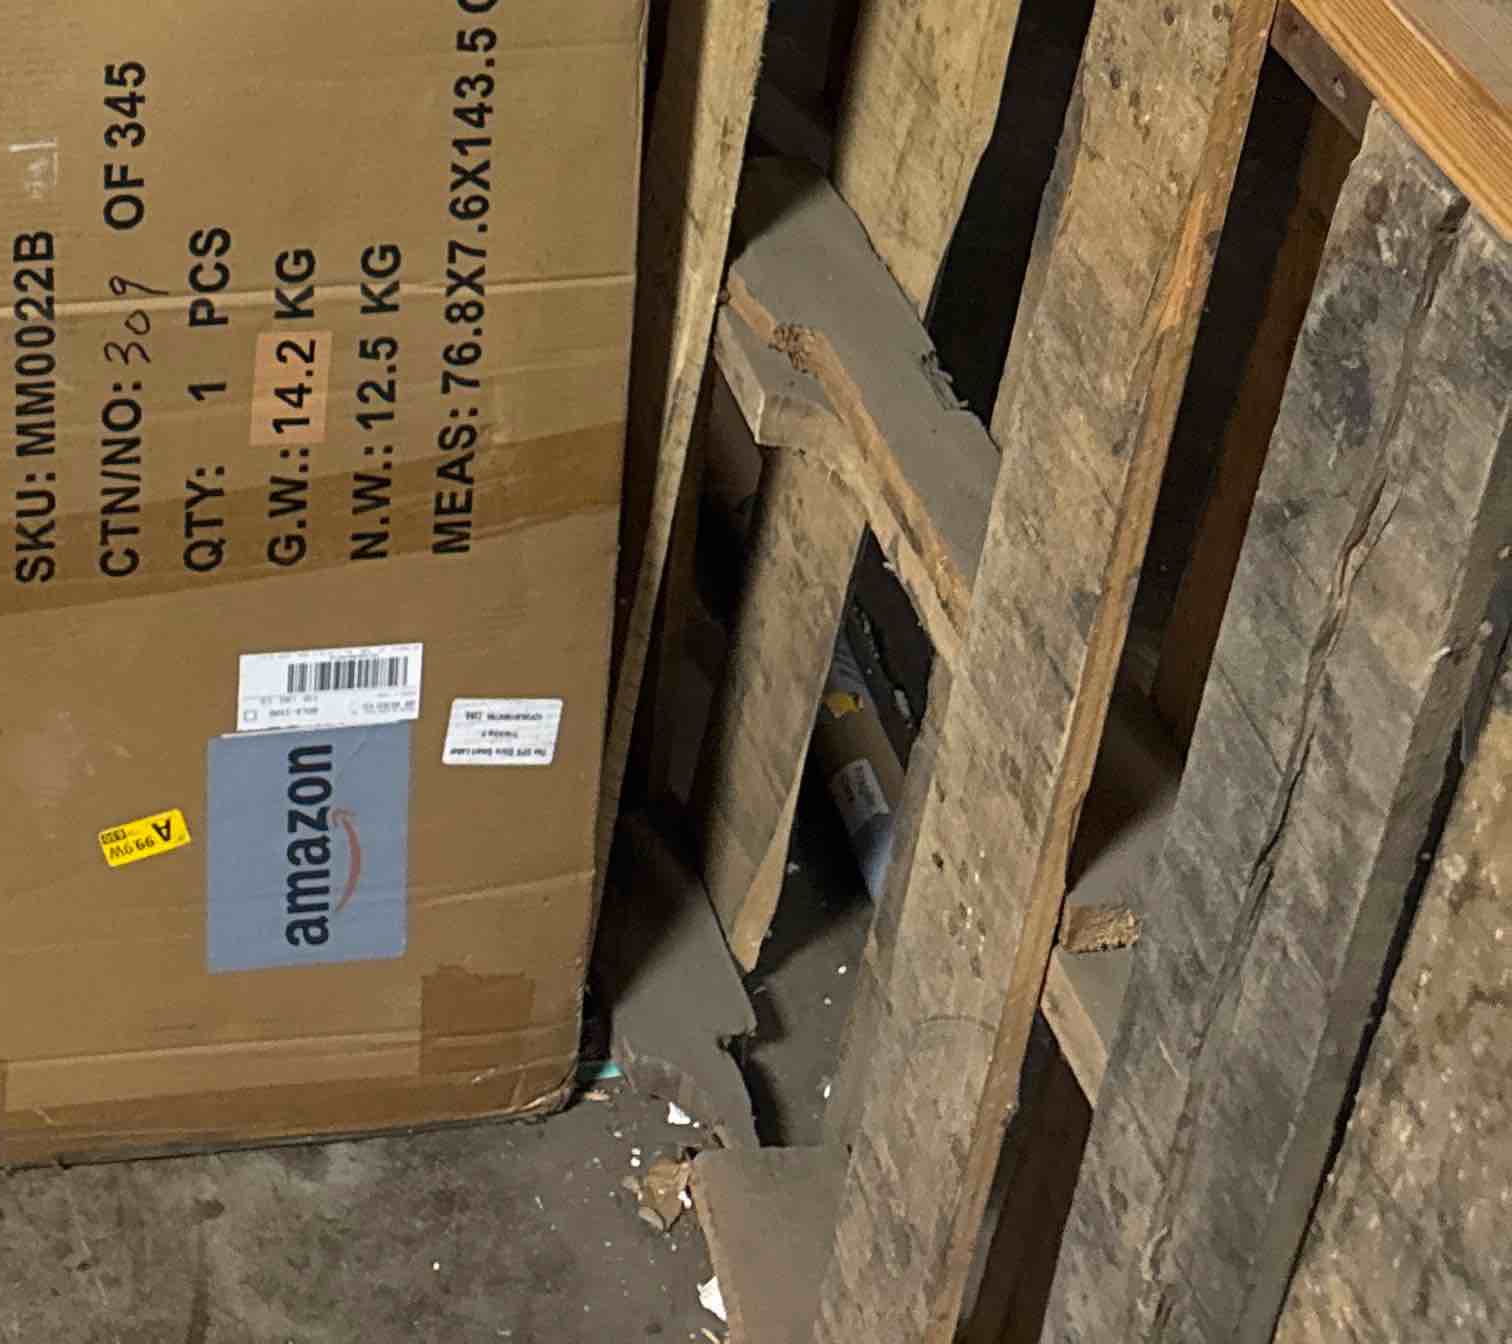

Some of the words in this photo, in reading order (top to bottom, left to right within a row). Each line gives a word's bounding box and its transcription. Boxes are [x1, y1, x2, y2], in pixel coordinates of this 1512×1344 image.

[103, 59, 147, 148] 345
[103, 162, 145, 231] OF
[188, 226, 232, 327] PCS
[274, 246, 317, 320] KG
[360, 241, 403, 315] KG
[13, 229, 57, 458] MM0022B
[189, 381, 227, 401] 1
[272, 338, 317, 434] 14.2
[356, 334, 400, 430] 12.5
[14, 470, 57, 584] SKU:
[99, 379, 143, 578] CTN/NO:
[183, 463, 225, 573] QTY:
[268, 447, 311, 566] G.W.:
[350, 443, 394, 561] N.W.:
[431, 406, 480, 554] MEAS:
[153, 816, 173, 841] A
[284, 743, 334, 947] amazon
